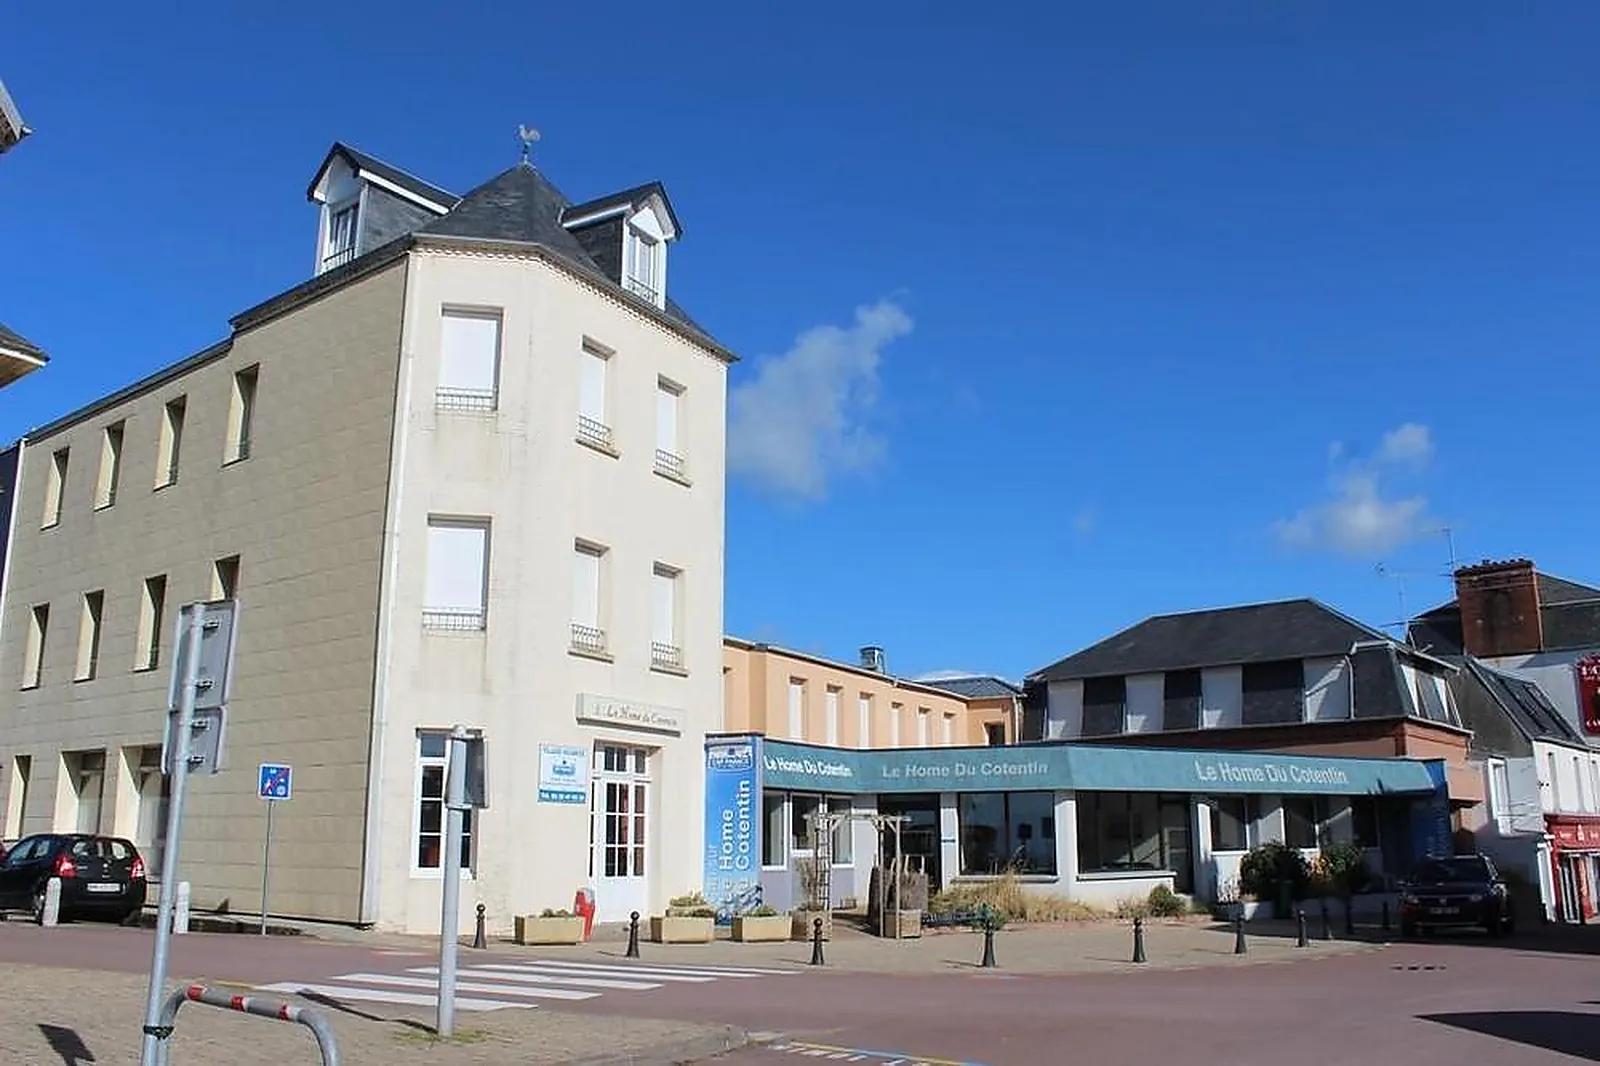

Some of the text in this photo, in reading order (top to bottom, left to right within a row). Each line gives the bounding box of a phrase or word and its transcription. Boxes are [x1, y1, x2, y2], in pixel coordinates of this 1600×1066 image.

[763, 755, 777, 770] Le
[777, 757, 804, 773] Home
[882, 761, 1048, 778] Le Home Du Cotentin
[1194, 760, 1349, 785] Le Home Du Cotentin
[736, 780, 750, 871] Cotentin
[719, 808, 734, 871] Home
